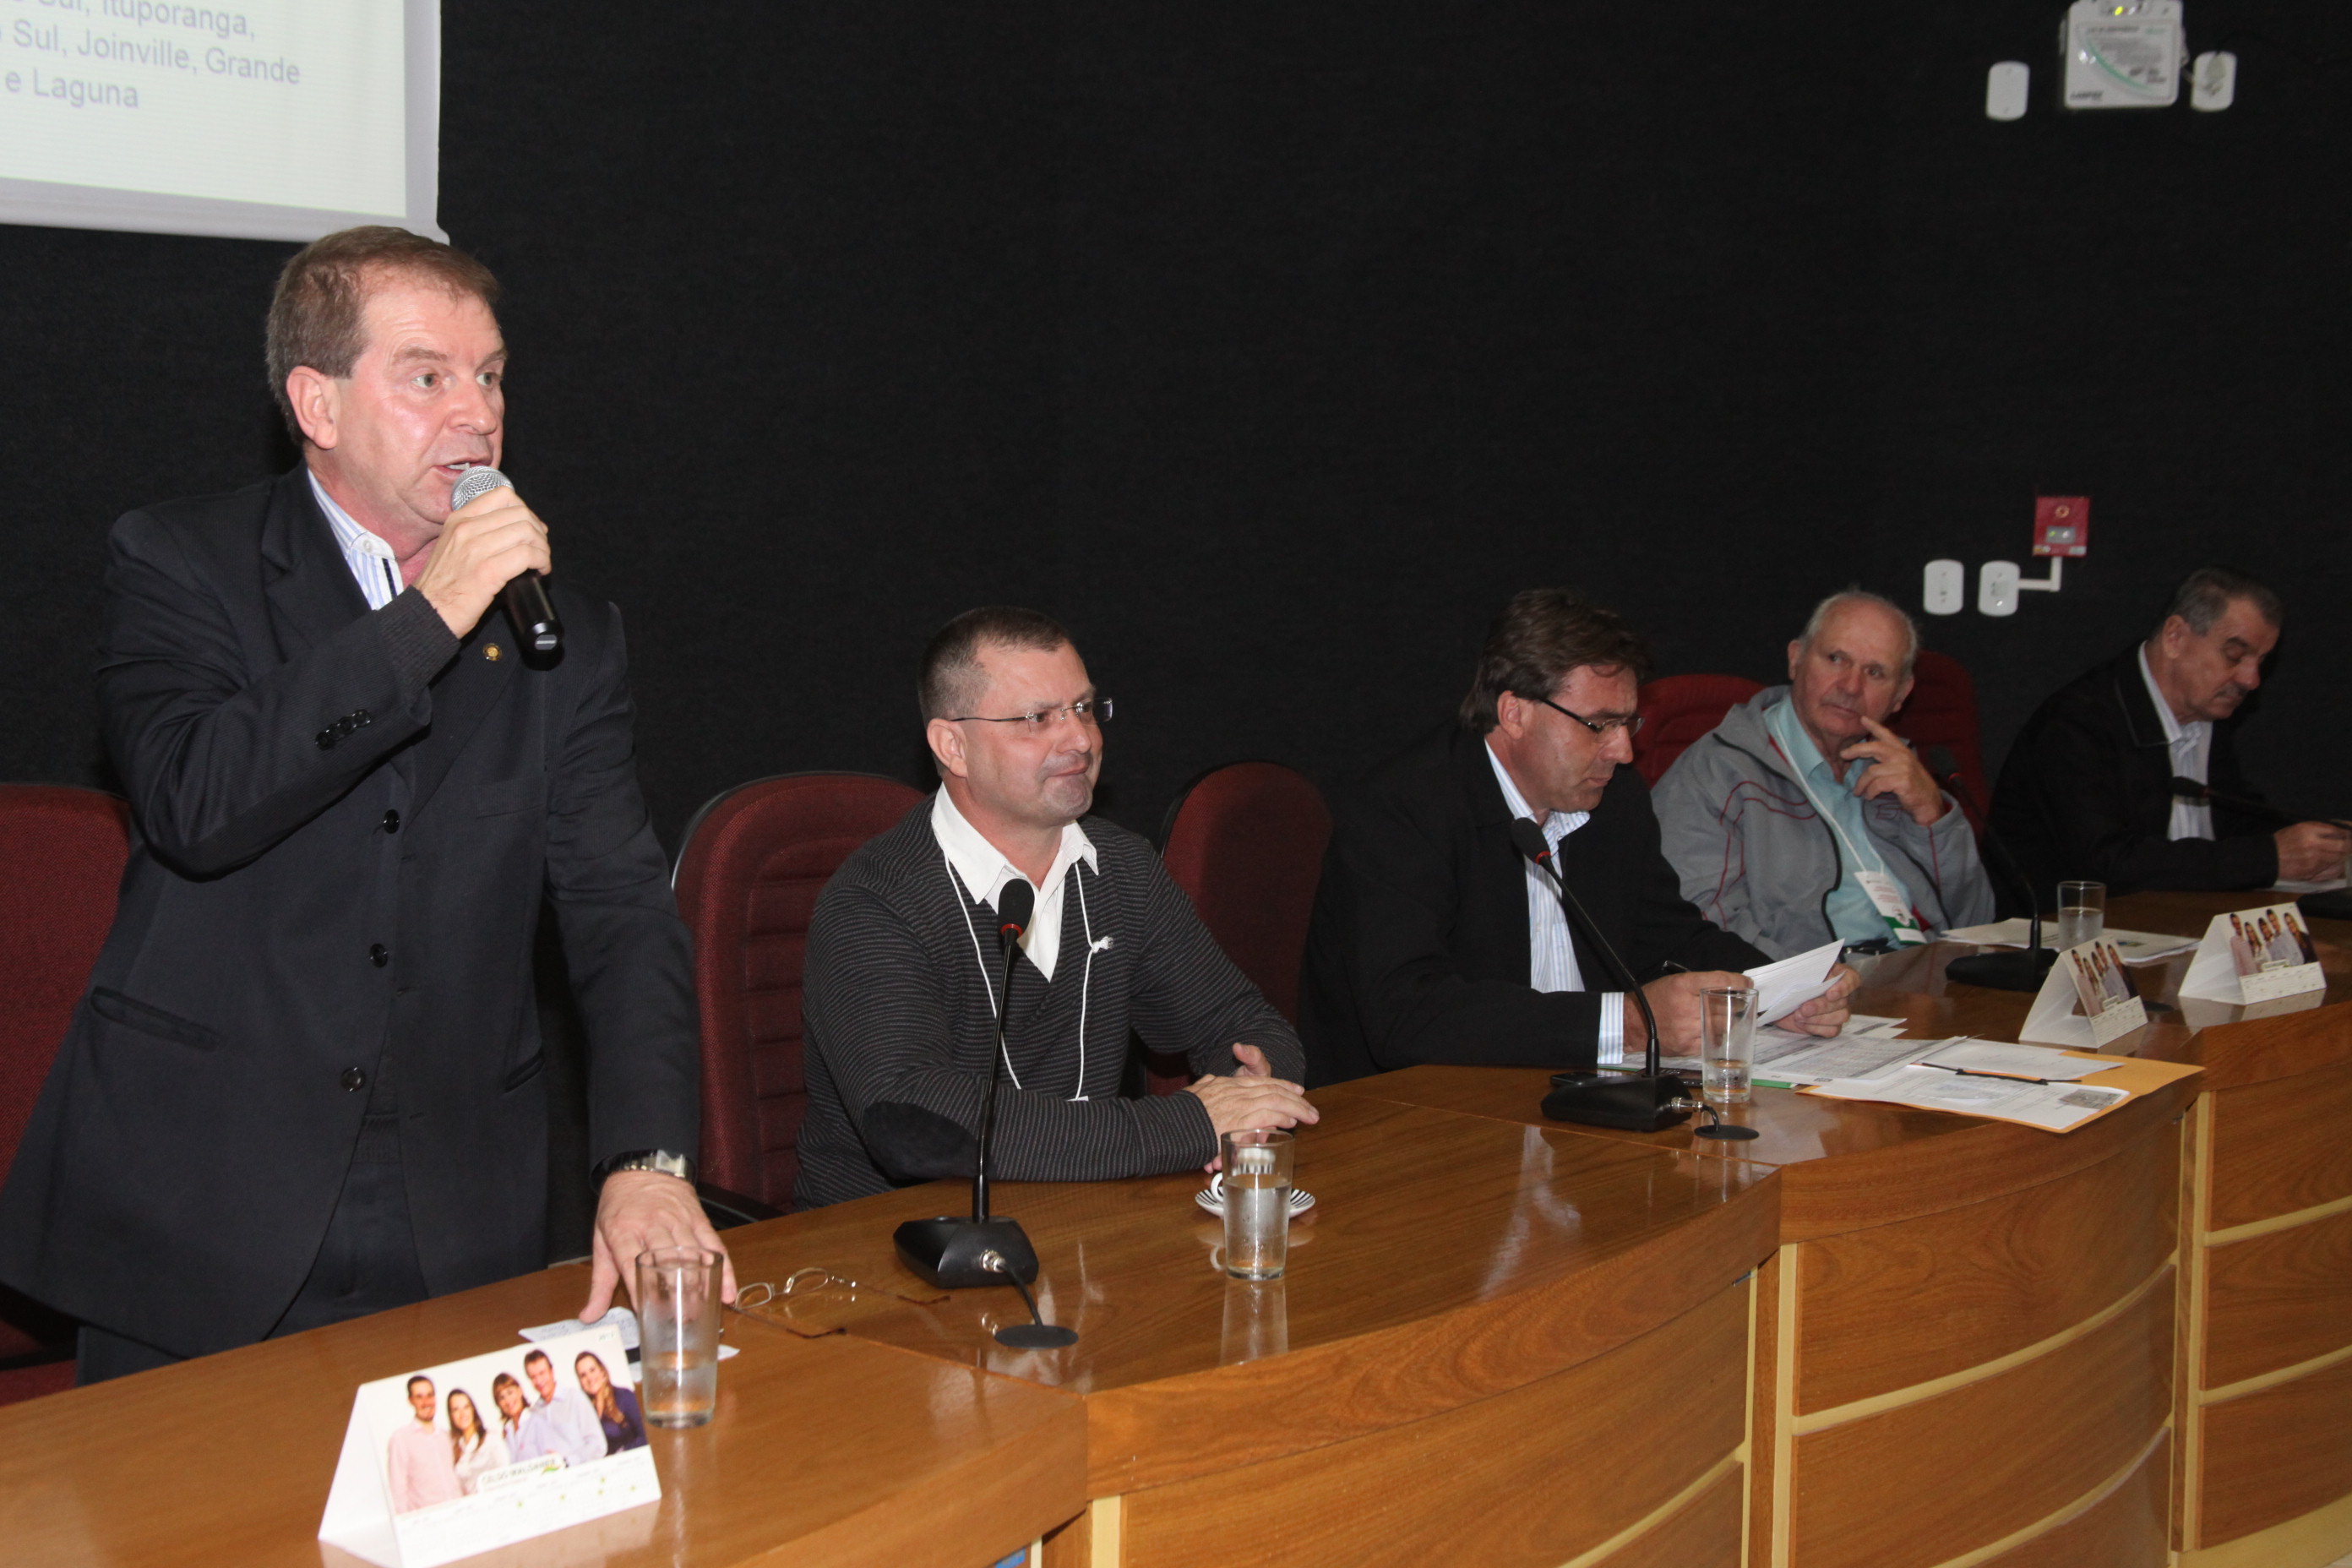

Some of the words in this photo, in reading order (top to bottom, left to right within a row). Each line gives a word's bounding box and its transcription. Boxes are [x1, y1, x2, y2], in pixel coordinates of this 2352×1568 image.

[102, 0, 255, 41] Ituporanga,
[13, 18, 68, 58] Sul,
[76, 29, 198, 75] Joinville,
[204, 46, 302, 86] Grande
[4, 71, 23, 95] e
[32, 67, 139, 110] Laguna
